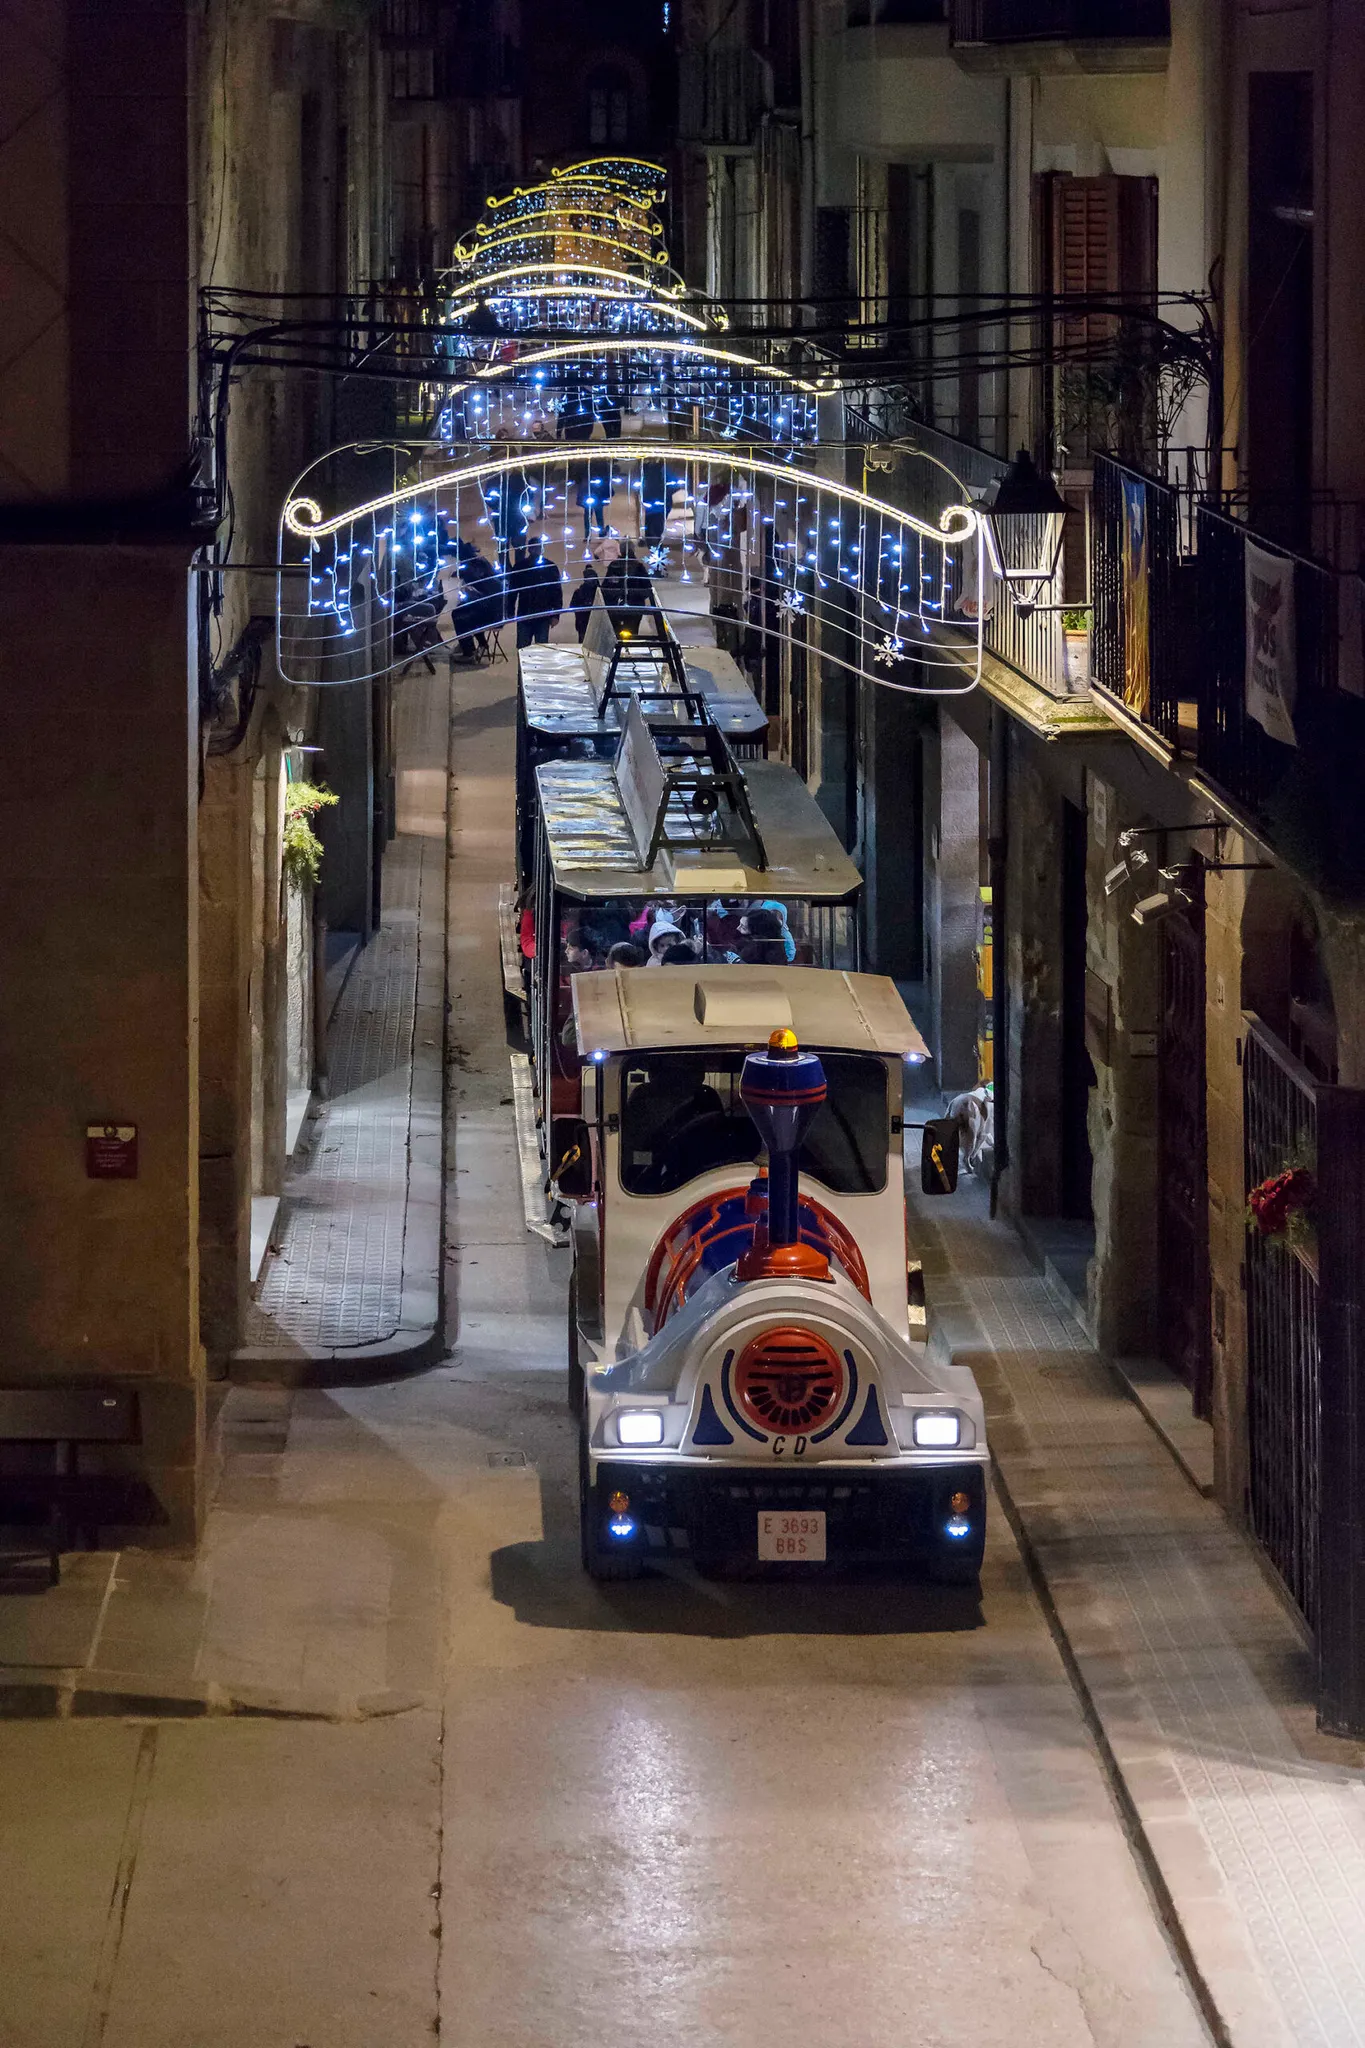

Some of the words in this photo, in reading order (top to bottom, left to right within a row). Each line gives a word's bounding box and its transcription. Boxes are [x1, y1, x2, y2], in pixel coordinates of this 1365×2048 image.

[764, 1518, 773, 1534] E
[781, 1518, 819, 1534] 3693
[776, 1538, 807, 1554] BBS
